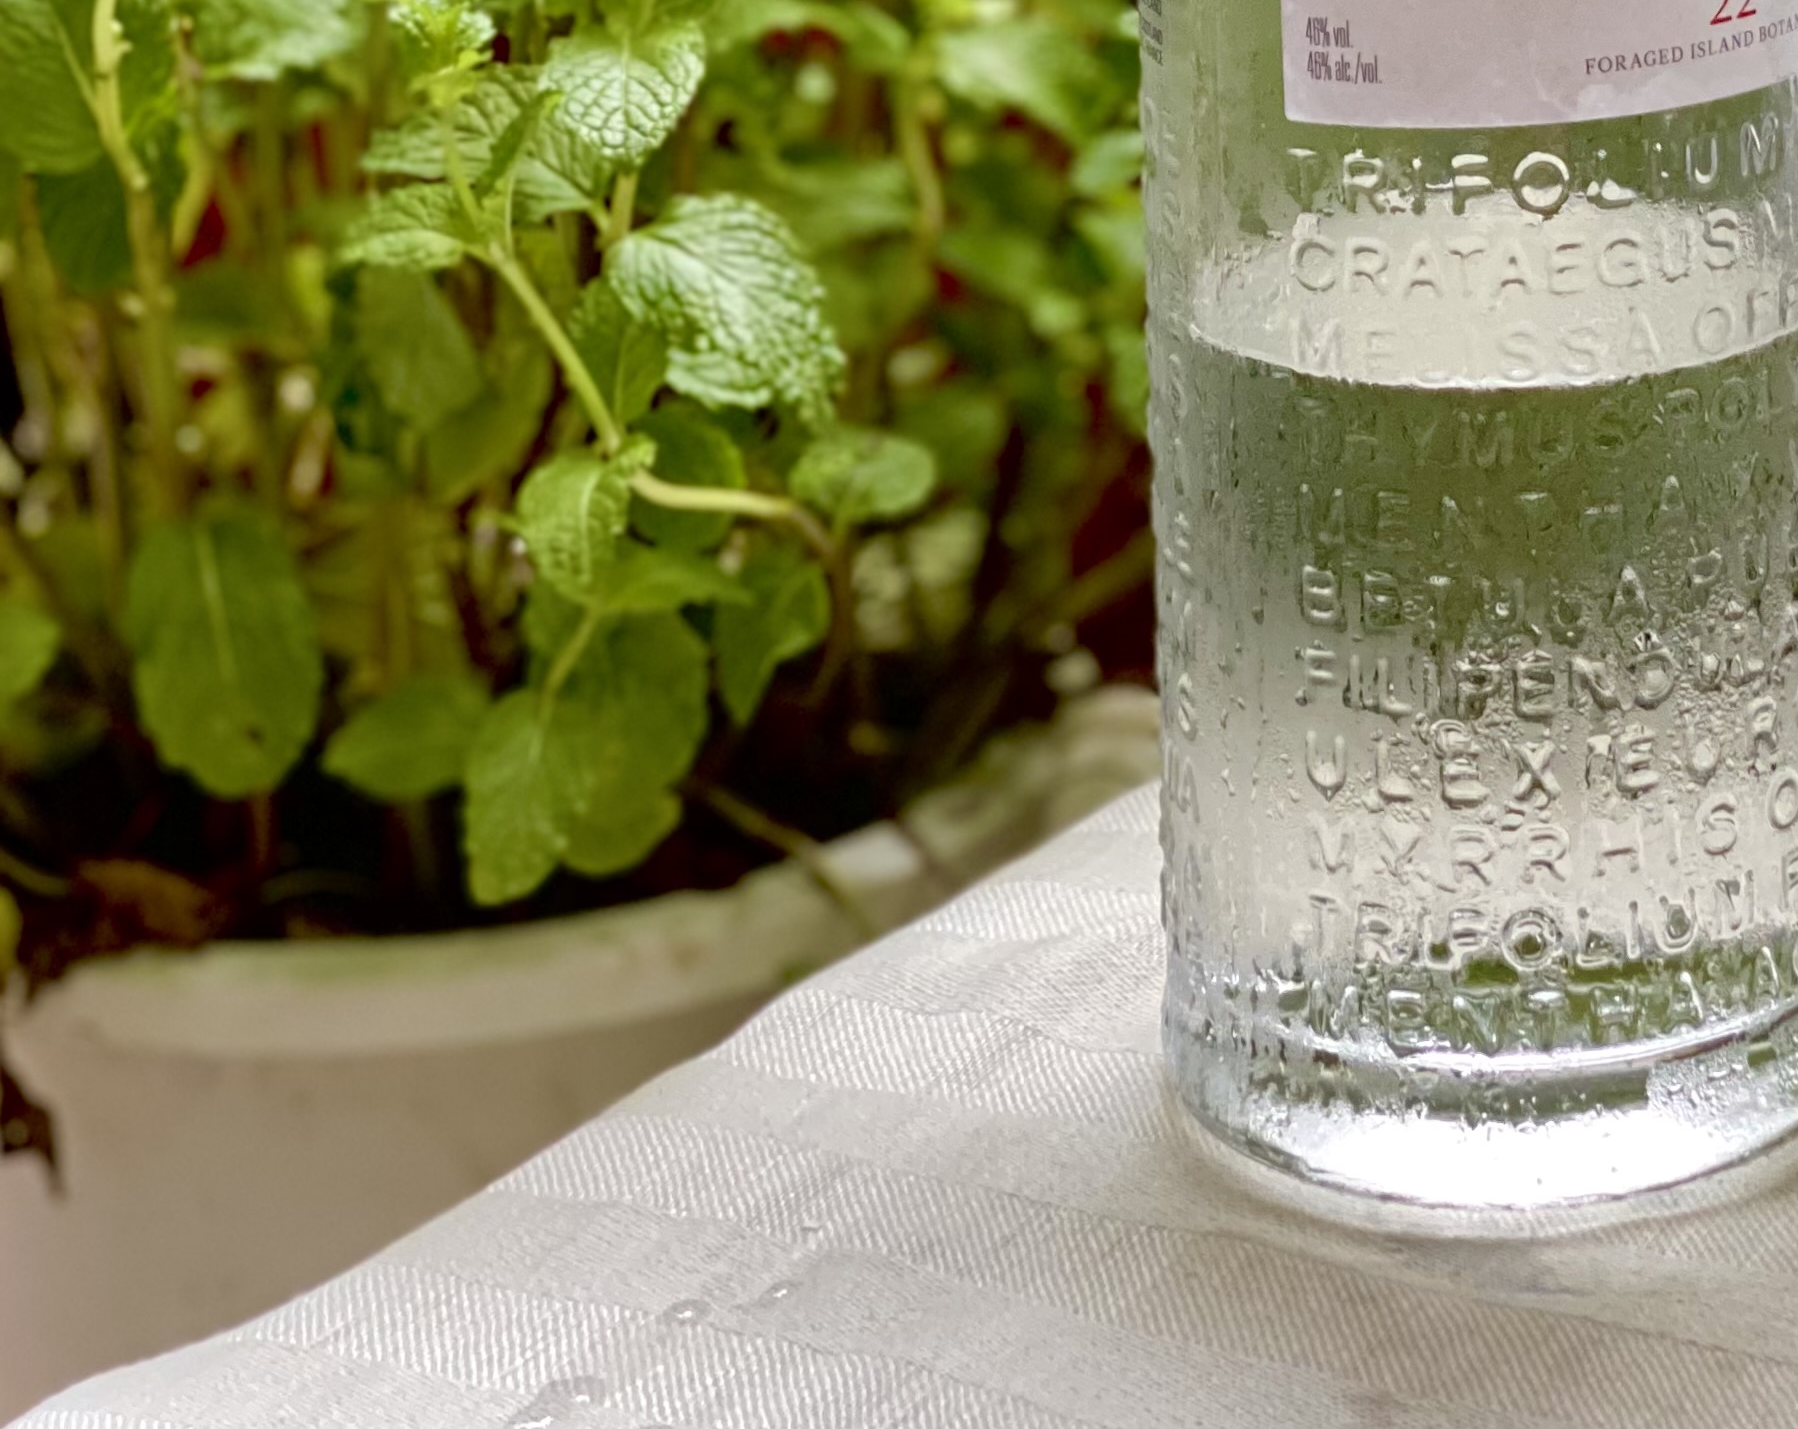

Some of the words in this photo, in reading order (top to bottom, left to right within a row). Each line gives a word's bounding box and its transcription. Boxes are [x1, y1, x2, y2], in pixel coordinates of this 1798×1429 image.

[1305, 16, 1331, 48] 46%
[1332, 18, 1355, 49] vol.
[1584, 45, 1684, 75] FORAGED
[1690, 30, 1754, 60] ISLAND
[1306, 50, 1333, 82] 46%
[1288, 206, 1740, 297] CRATAEGUS
[1304, 727, 1562, 811] ULEX
